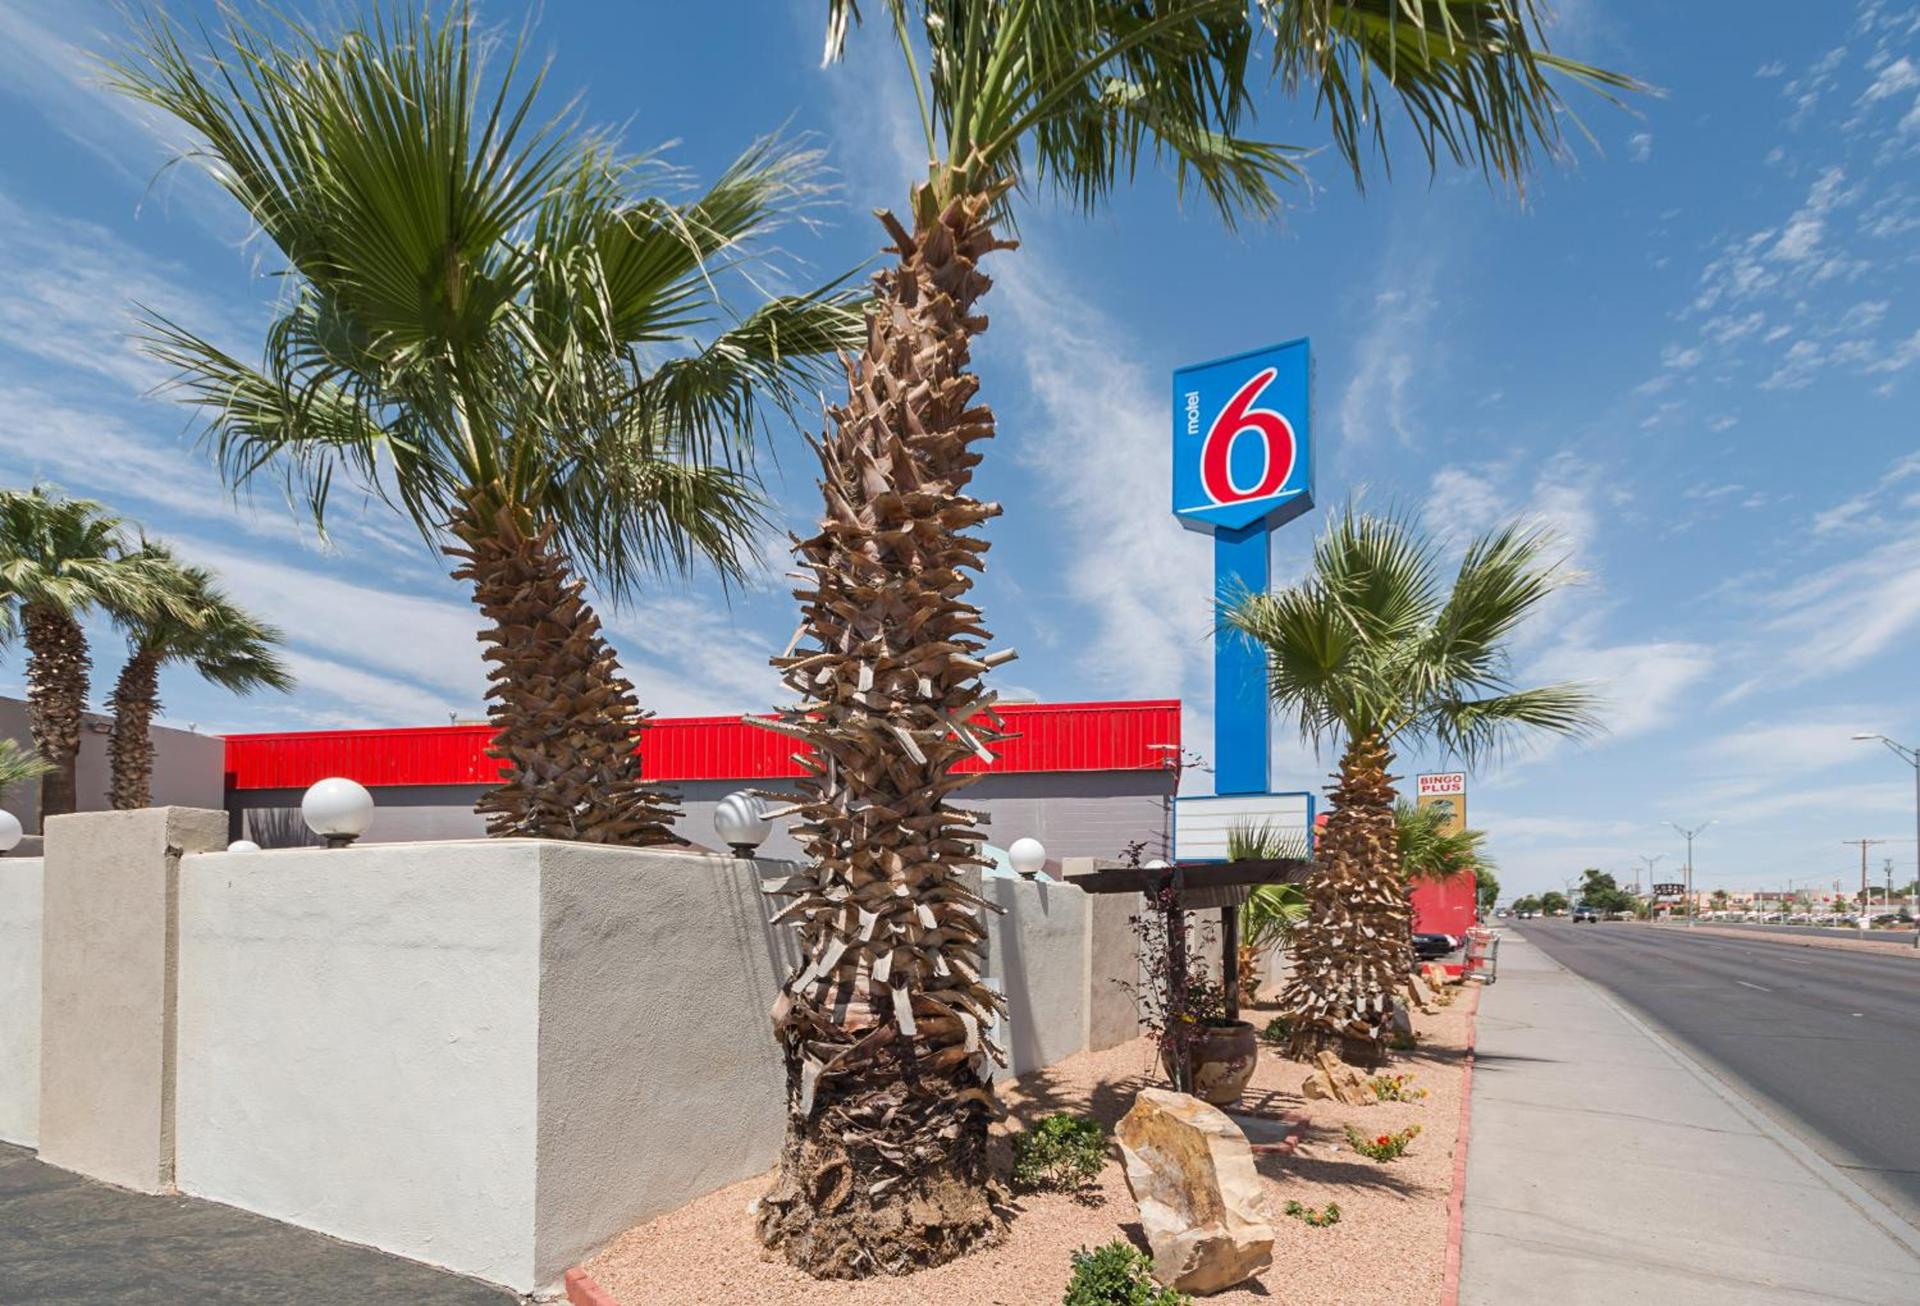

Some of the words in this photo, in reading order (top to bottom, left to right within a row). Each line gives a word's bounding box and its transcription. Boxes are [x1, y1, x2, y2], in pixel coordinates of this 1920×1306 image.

[1185, 391, 1200, 435] motel
[1200, 367, 1297, 504] 6
[1420, 775, 1462, 784] BINGO
[1422, 784, 1461, 792] PLUS
